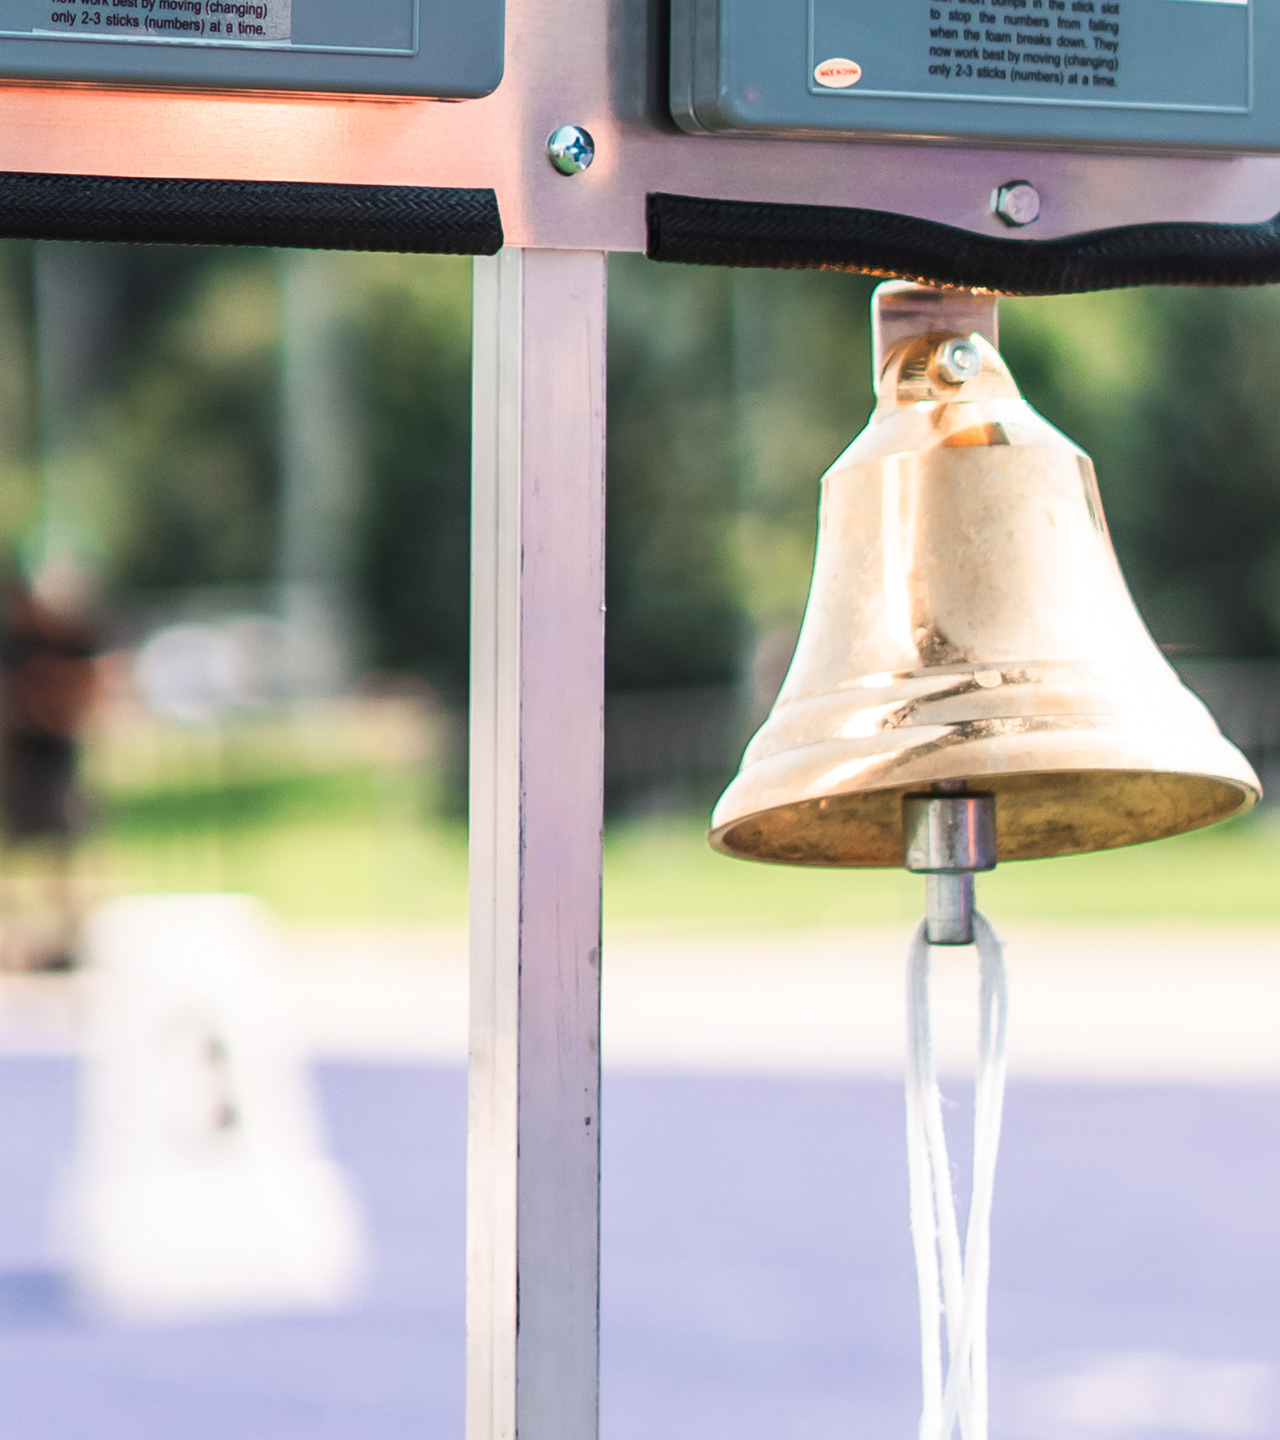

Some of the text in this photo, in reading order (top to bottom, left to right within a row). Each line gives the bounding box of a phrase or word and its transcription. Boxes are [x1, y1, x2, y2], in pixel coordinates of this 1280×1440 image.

[159, 0, 201, 15] moving
[205, 1, 267, 18] (changing)
[1072, 0, 1094, 13] stick
[1101, 3, 1119, 15] slot
[52, 12, 266, 35] only 2-3 sticks (numbers) at a time.
[930, 8, 1118, 35] to stop the numbers from falling
[930, 27, 1118, 54] when the foam breaks down. They
[929, 47, 1118, 72] now work best by moving (changing)
[929, 64, 1117, 87] only 2-3 sticks (numbers) at a time.
